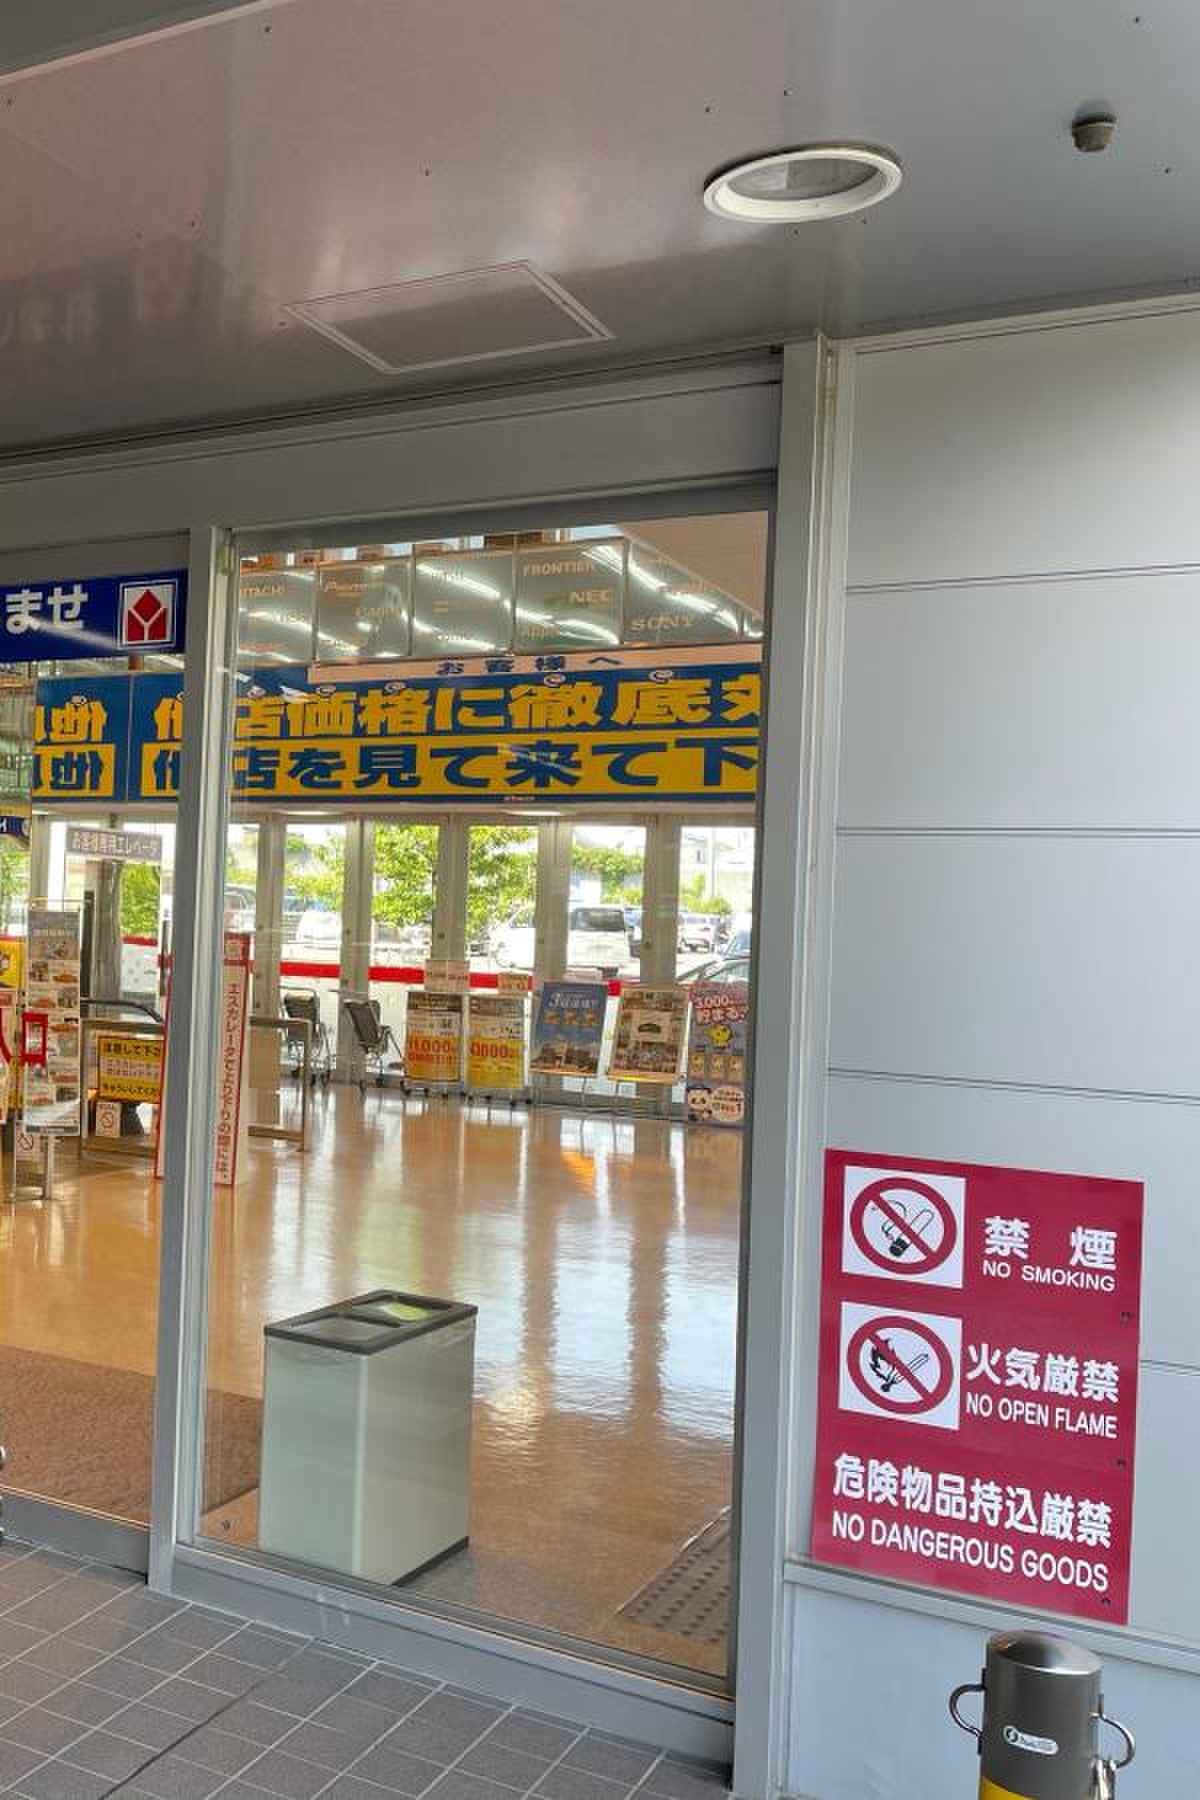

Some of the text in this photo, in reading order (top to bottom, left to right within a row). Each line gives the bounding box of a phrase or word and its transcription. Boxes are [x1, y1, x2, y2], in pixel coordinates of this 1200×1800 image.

[522, 560, 594, 576] FRONTIER
[569, 589, 613, 605] NEC
[631, 615, 694, 632] SONY
[984, 1215, 1118, 1271] 禁煙
[982, 1259, 1116, 1292] NO SMOKING
[965, 1343, 1119, 1403] 火気厳禁
[966, 1391, 1118, 1439] NO OPEN FLAME
[832, 1452, 1113, 1549] 危険物品持込厳禁
[832, 1510, 1109, 1593] NO DANGEROUS GOODS
